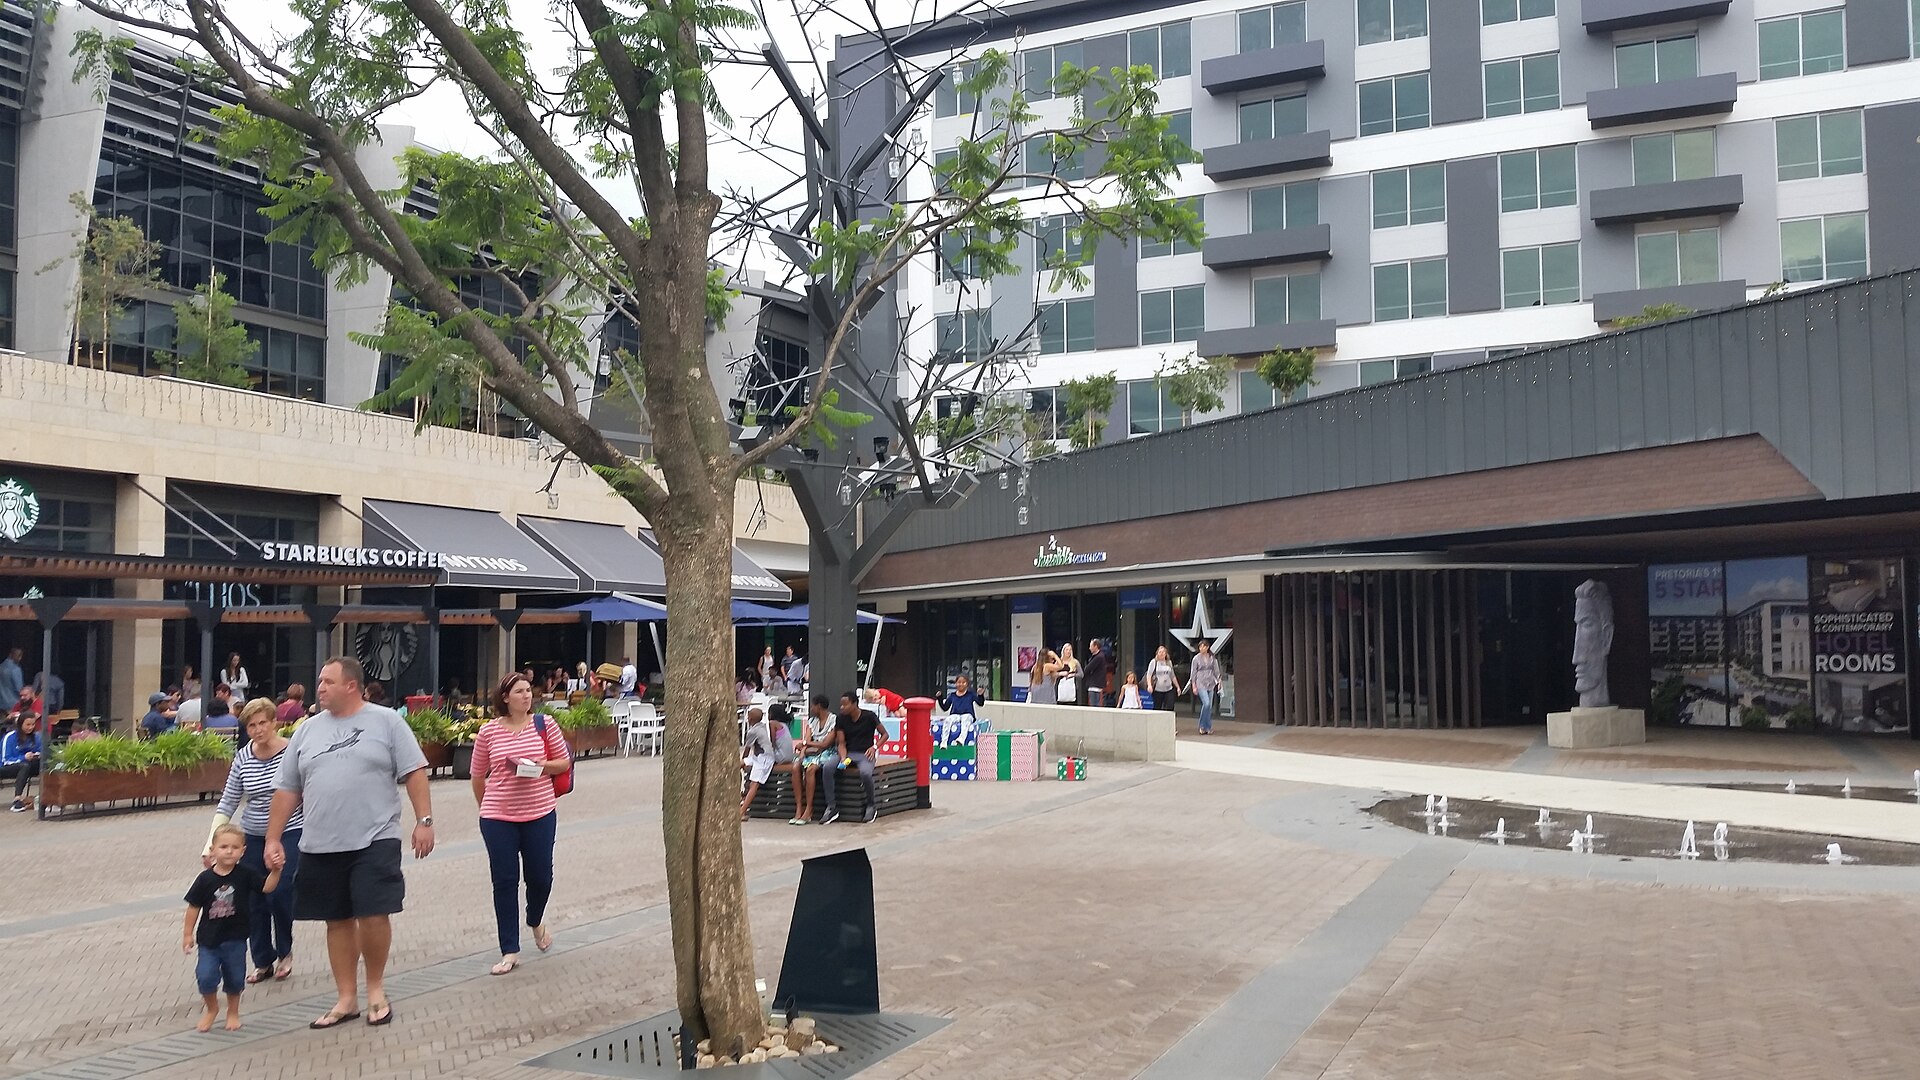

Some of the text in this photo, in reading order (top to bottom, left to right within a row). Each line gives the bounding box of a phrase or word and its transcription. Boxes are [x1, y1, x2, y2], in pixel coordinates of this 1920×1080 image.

[262, 542, 447, 568] STARBUCKS COFFEE
[445, 554, 528, 573] MYTHOS
[1655, 580, 1666, 599] 5
[1813, 611, 1894, 624] SOPHISTICATED
[1822, 622, 1893, 633] CONTEMPORARY
[1815, 632, 1894, 652] HOTEL
[1815, 653, 1896, 672] ROOMS
